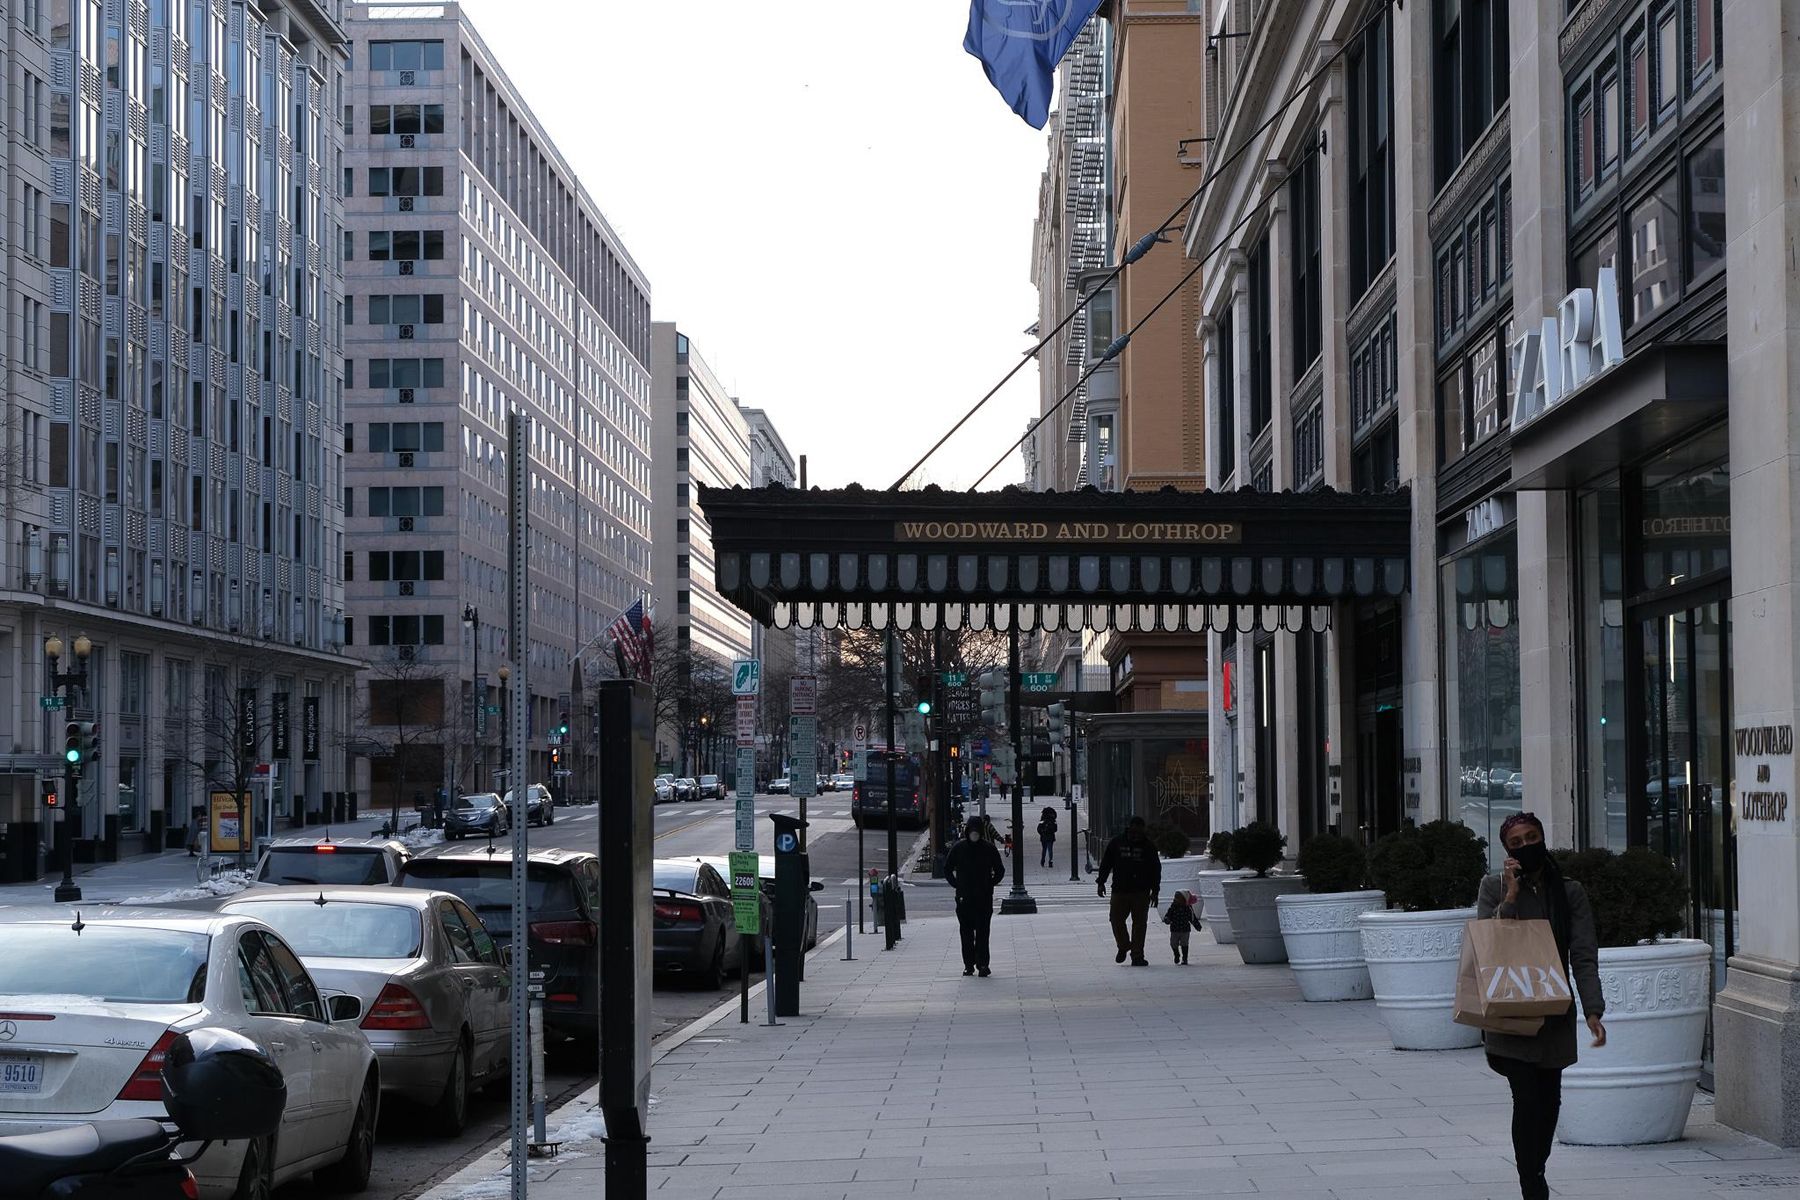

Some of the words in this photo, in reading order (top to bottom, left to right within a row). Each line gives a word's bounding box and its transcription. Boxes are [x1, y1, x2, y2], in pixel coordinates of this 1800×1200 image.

[1511, 267, 1624, 432] ZARA
[903, 522, 1048, 540] WOODWARD
[1056, 523, 1110, 540] AND
[1116, 523, 1234, 541] LOTHROP
[1466, 497, 1504, 543] ZARA
[752, 662, 758, 675] 2
[1028, 674, 1038, 684] 11
[1735, 725, 1793, 756] WOODWARD
[47, 795, 56, 804] 13
[1156, 775, 1201, 807] PRET
[1741, 791, 1788, 822] LOTHROP
[1480, 965, 1572, 1000] ZARA
[5, 1064, 36, 1082] 9510
